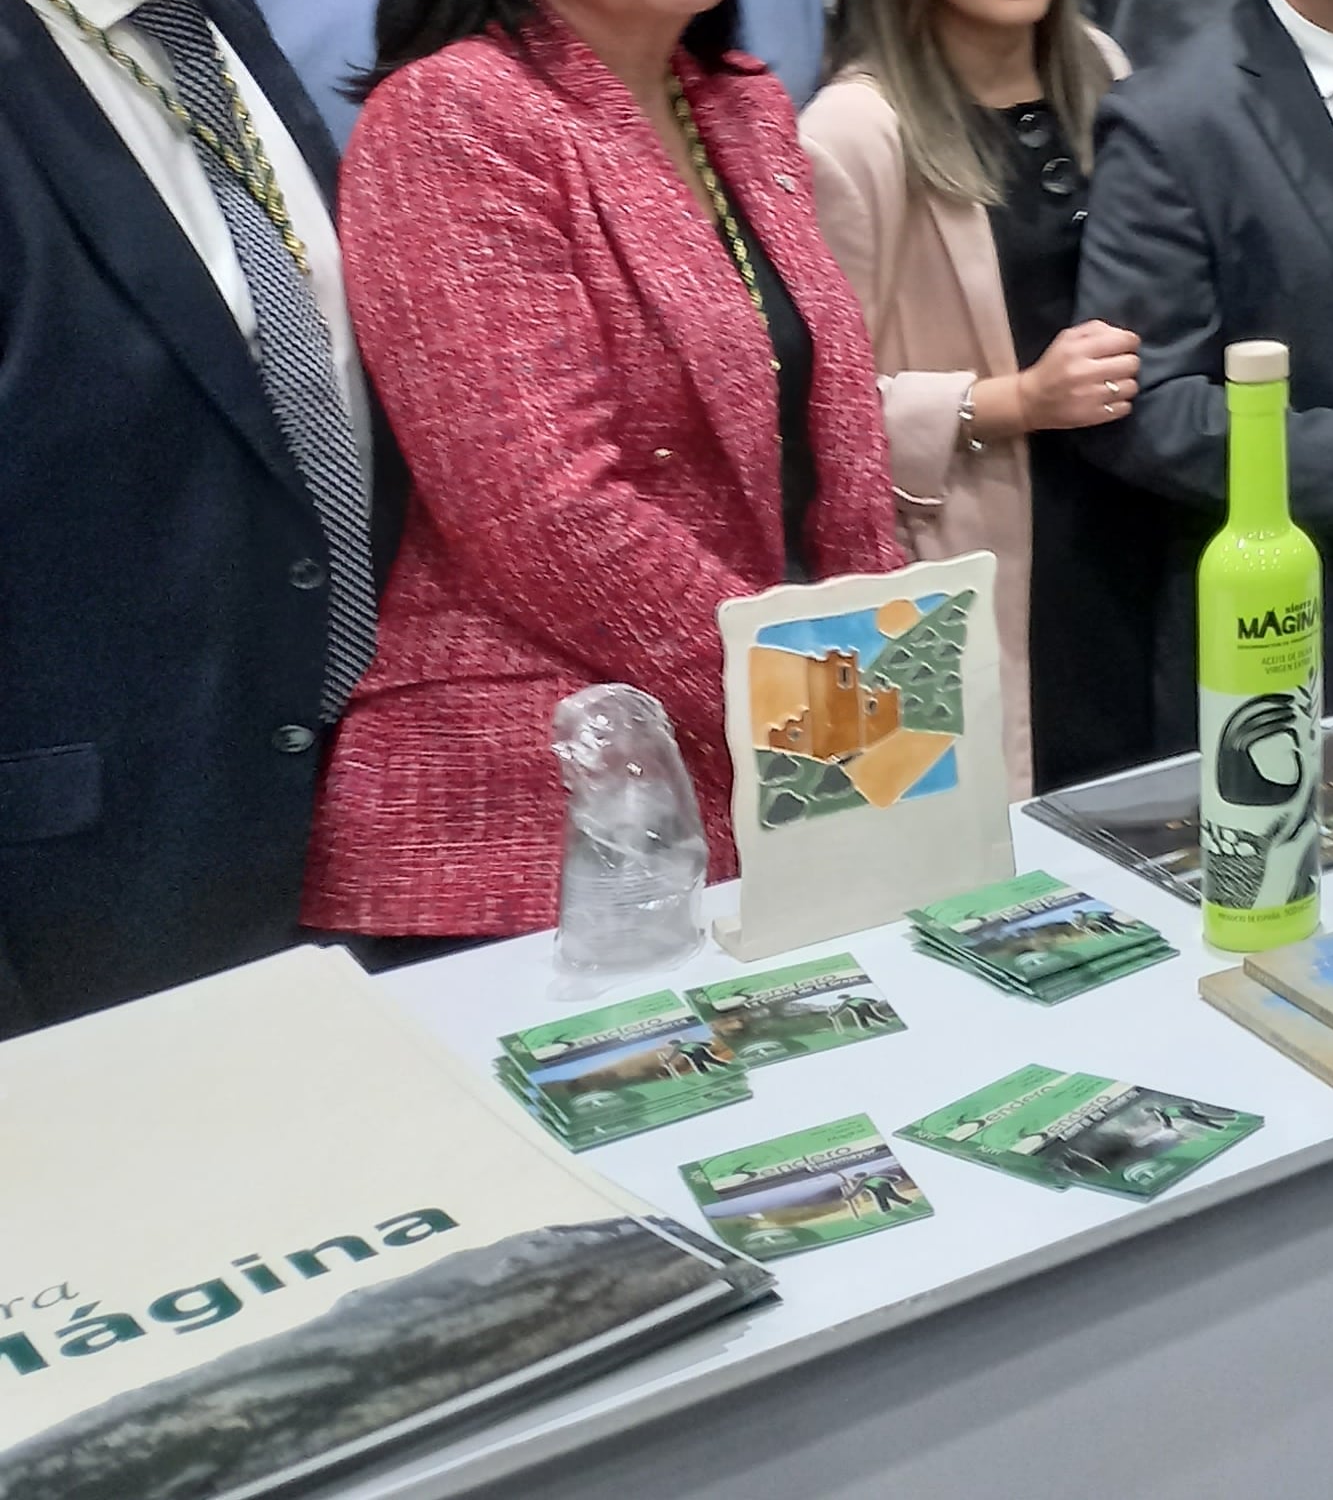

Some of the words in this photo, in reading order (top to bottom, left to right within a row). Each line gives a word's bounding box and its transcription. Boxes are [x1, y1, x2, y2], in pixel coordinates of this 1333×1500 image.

[734, 973, 837, 1003] Sendero
[552, 1017, 662, 1051] Sendero
[956, 1084, 1057, 1131] Sendero
[1018, 1094, 1112, 1142] Sendero
[732, 1146, 851, 1182] Sendero
